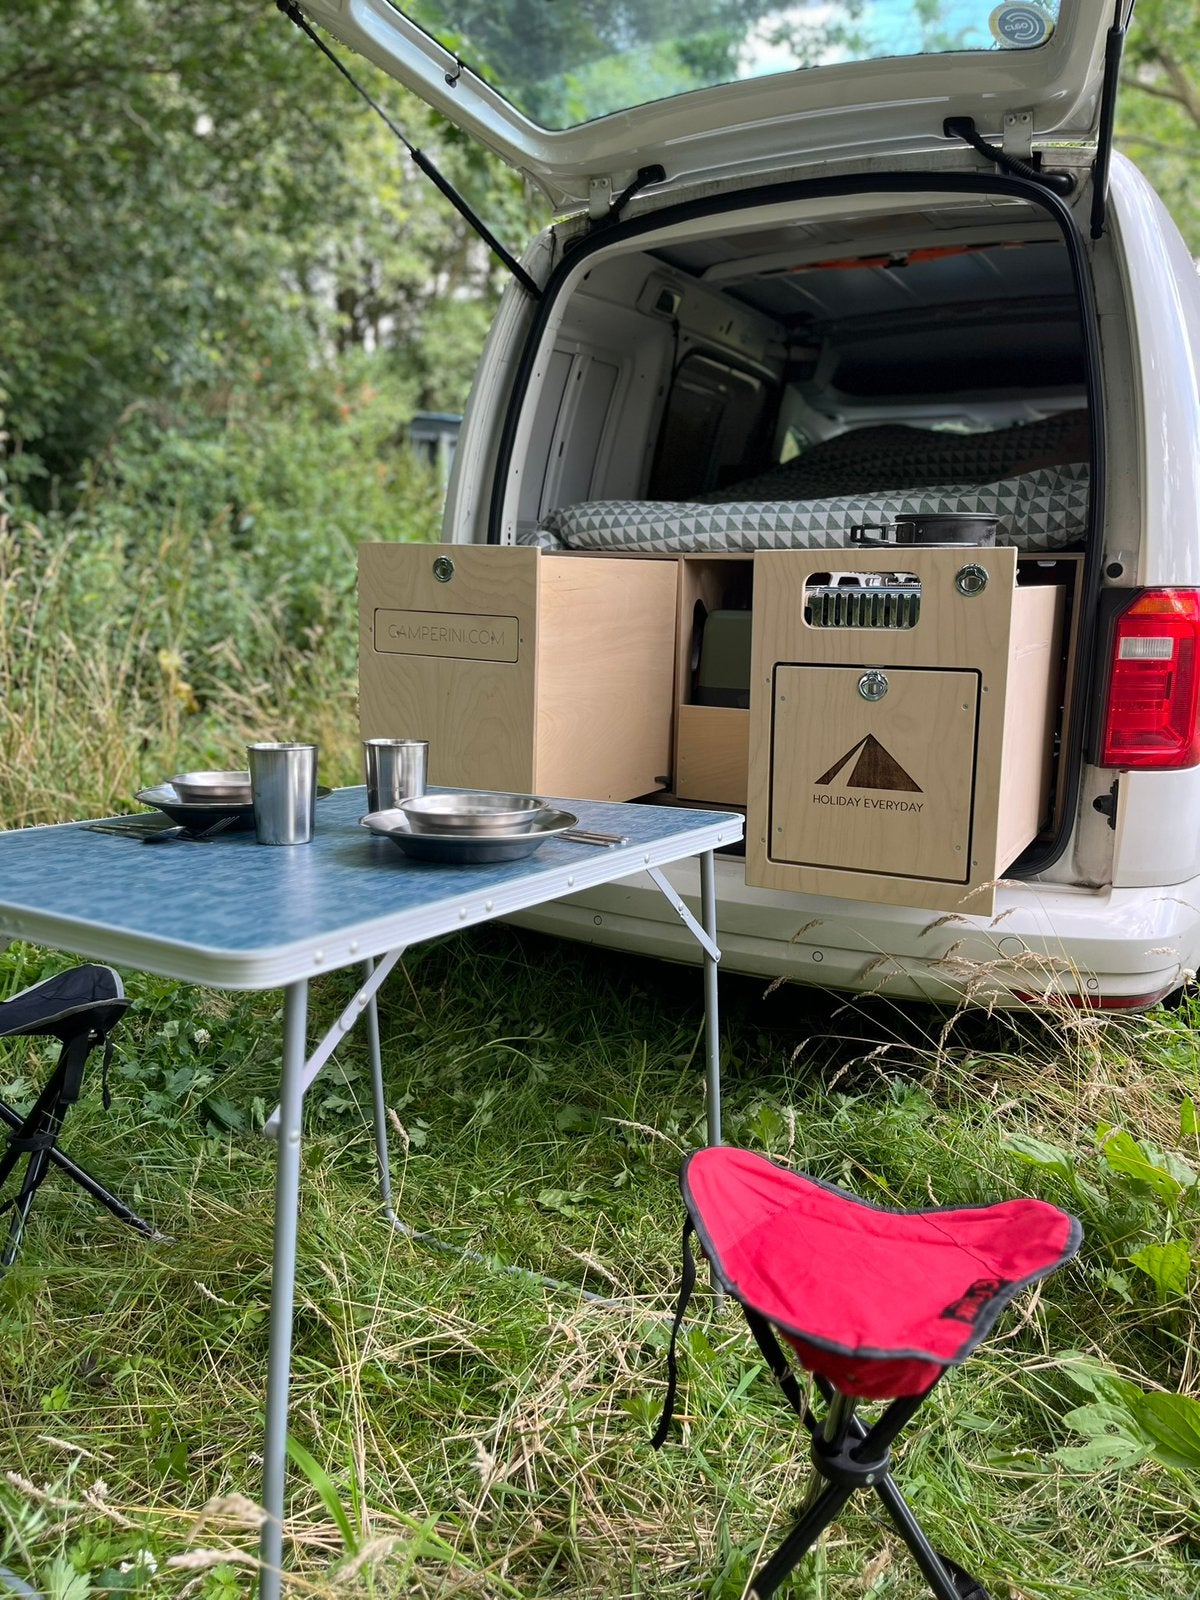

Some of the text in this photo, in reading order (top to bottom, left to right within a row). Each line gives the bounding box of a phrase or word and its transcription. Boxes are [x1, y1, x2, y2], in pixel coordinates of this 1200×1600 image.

[388, 624, 505, 646] CAMPERINI.COM
[812, 794, 924, 812] HOLIDAY EVERYDAY
